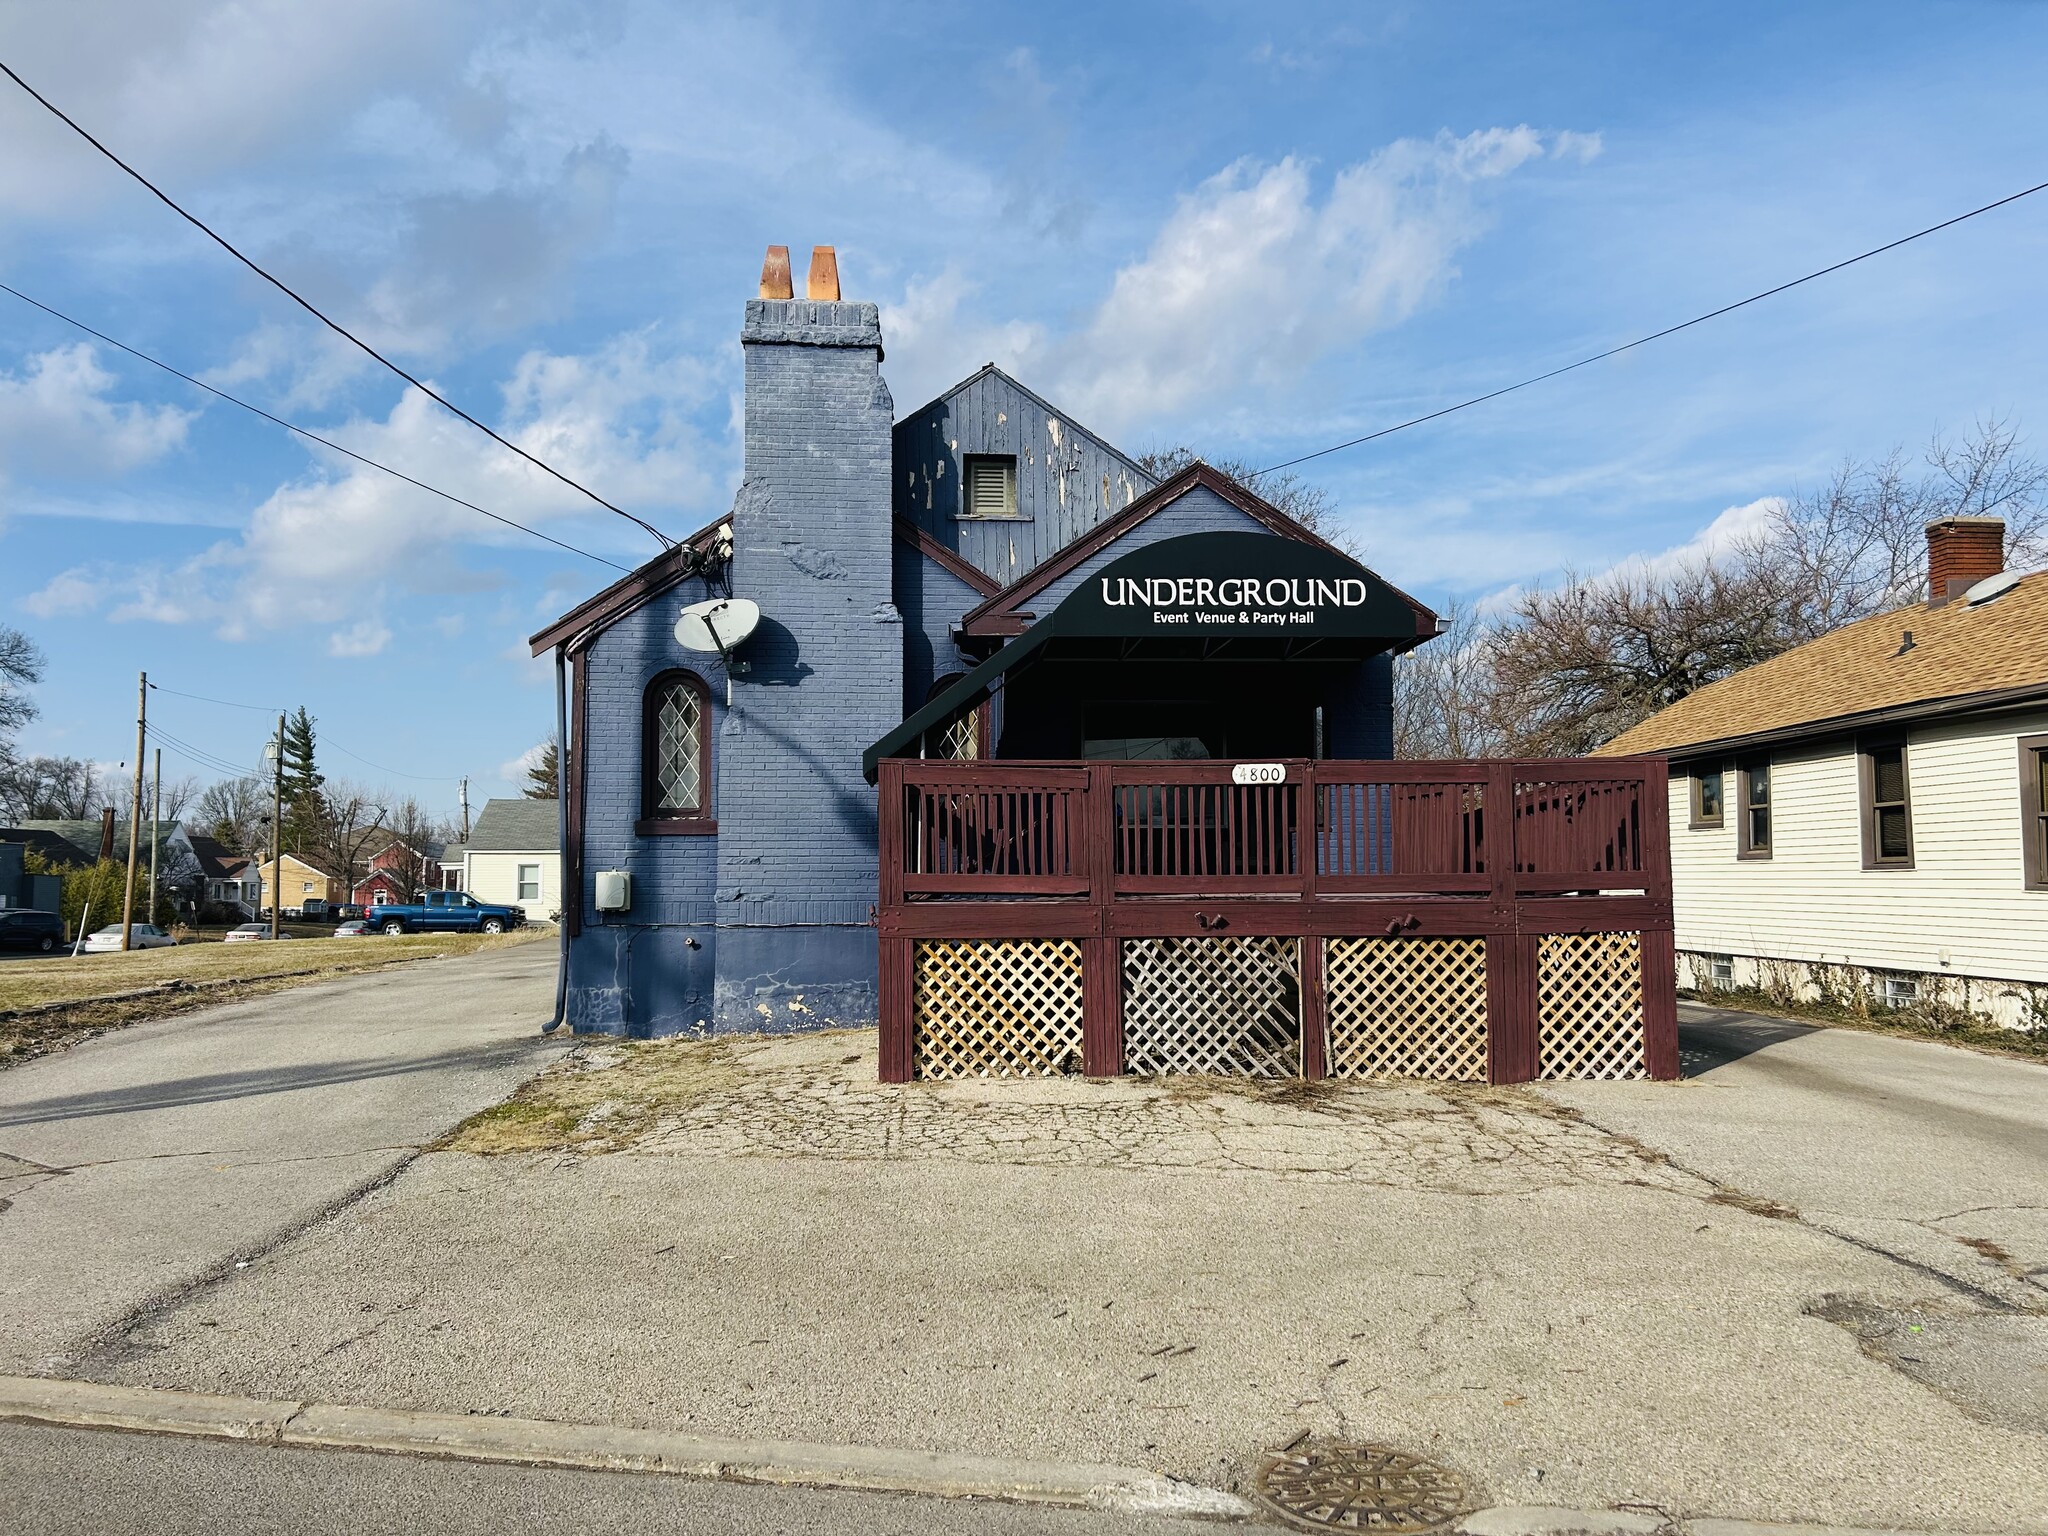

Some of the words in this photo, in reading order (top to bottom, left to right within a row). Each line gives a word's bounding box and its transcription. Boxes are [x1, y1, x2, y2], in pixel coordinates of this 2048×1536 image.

[1101, 577, 1367, 608] UNDERGROUND
[1153, 611, 1189, 624] Event
[1194, 611, 1236, 624] Venue
[1238, 611, 1250, 624] &
[1252, 611, 1287, 626] Party
[1289, 611, 1315, 624] Hall
[1239, 767, 1280, 782] 4800
